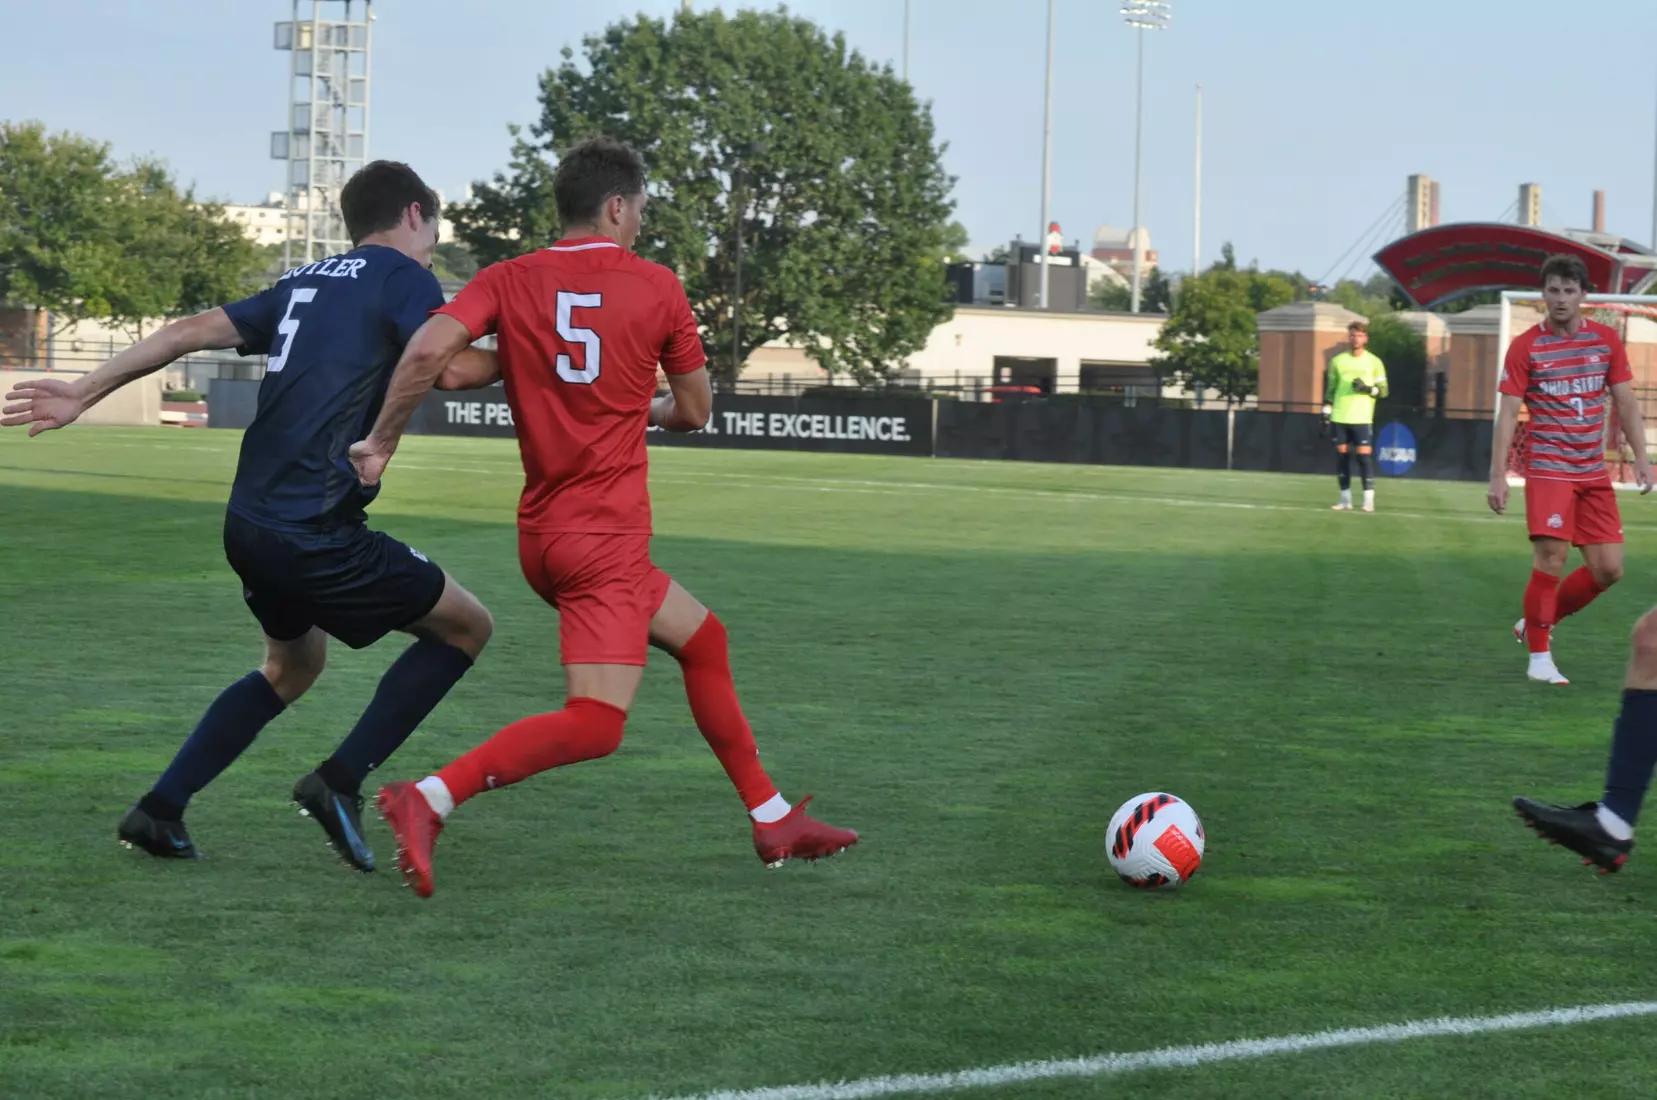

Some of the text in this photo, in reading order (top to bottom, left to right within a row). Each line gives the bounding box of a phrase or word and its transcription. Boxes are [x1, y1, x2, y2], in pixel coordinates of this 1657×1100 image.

[266, 288, 318, 372] 5
[555, 290, 603, 385] 5
[444, 401, 482, 424] THE
[723, 411, 765, 436] THE
[768, 413, 912, 442] EXCELLENCE.
[1570, 397, 1584, 420] 7
